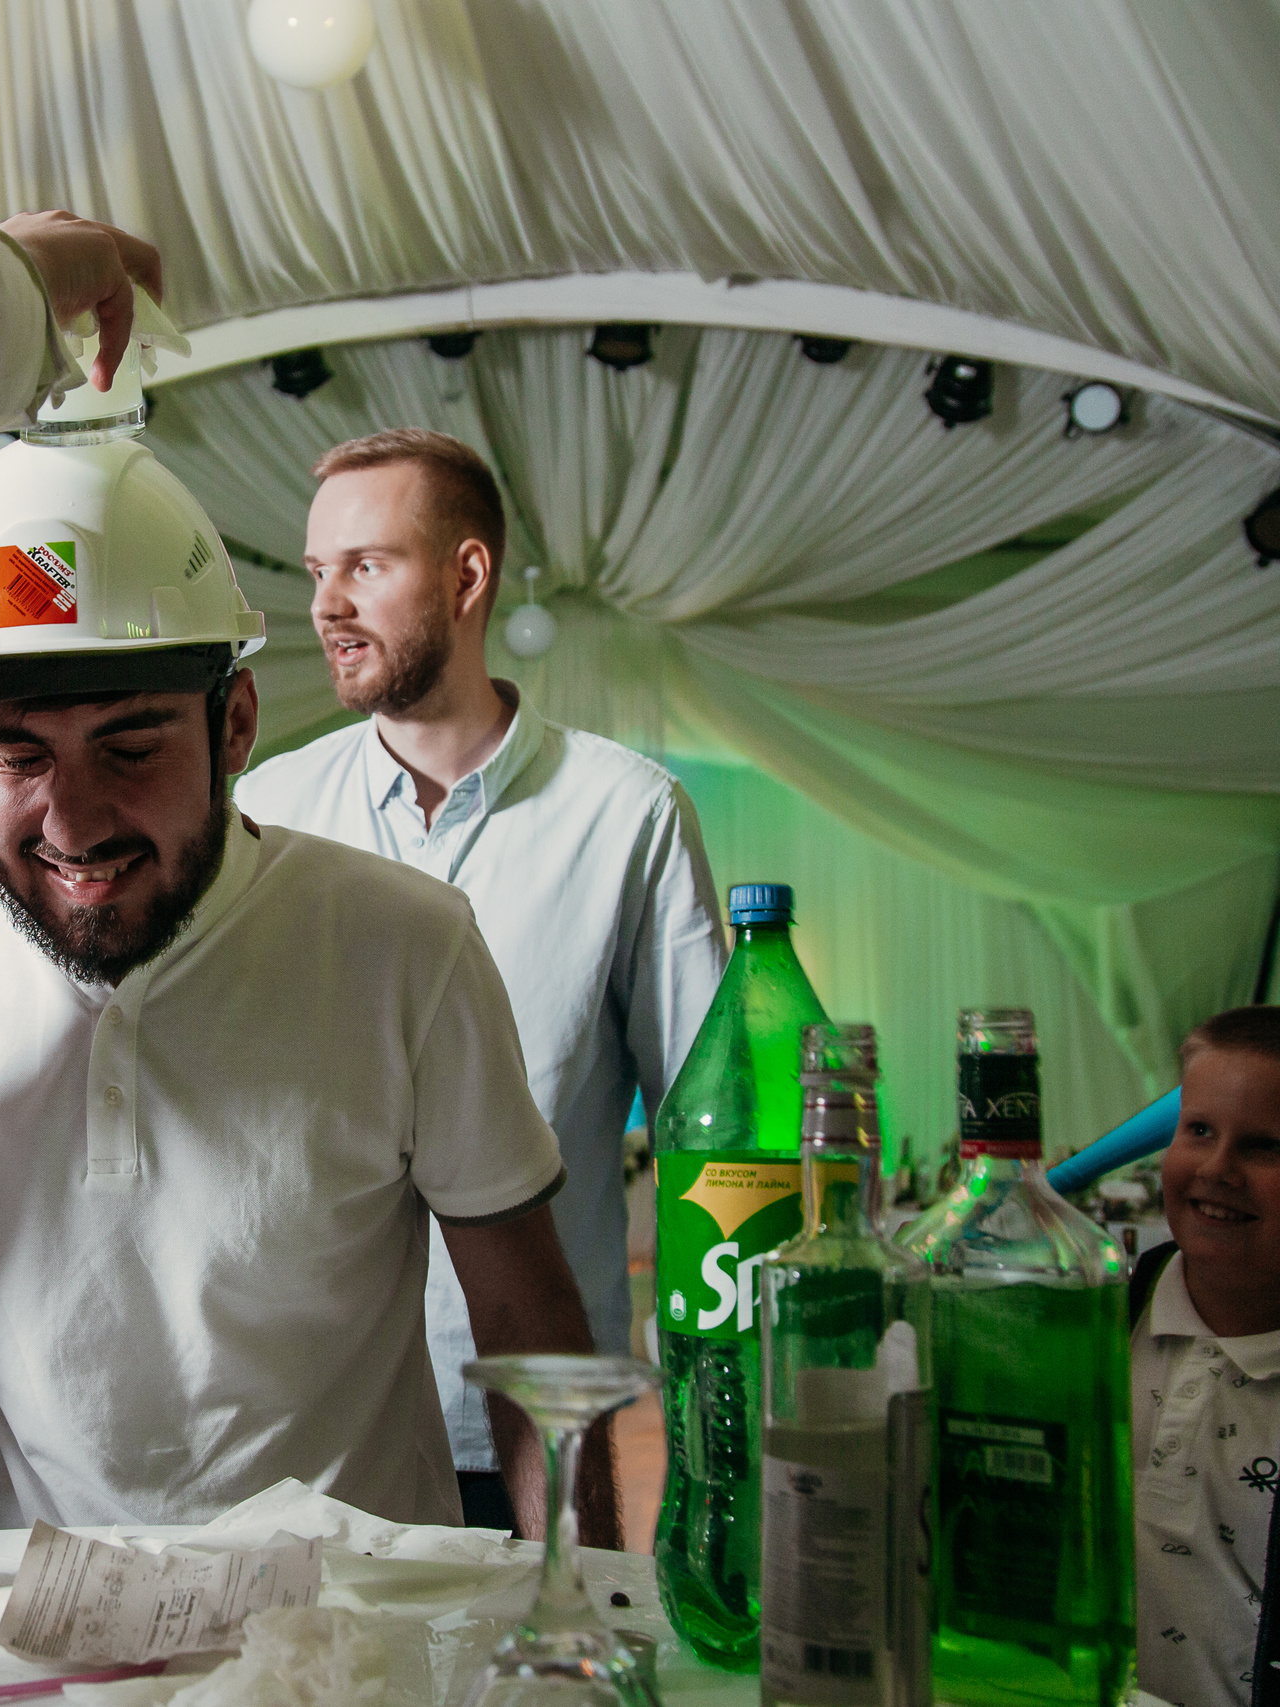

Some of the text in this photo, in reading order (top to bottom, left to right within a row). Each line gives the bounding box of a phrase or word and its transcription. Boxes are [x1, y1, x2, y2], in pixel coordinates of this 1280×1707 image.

[26, 546, 71, 589] KRAFTER
[705, 1168, 758, 1179] СО ВКУСОМ
[704, 1178, 792, 1190] ЛИМОНА И ЛАЙМА
